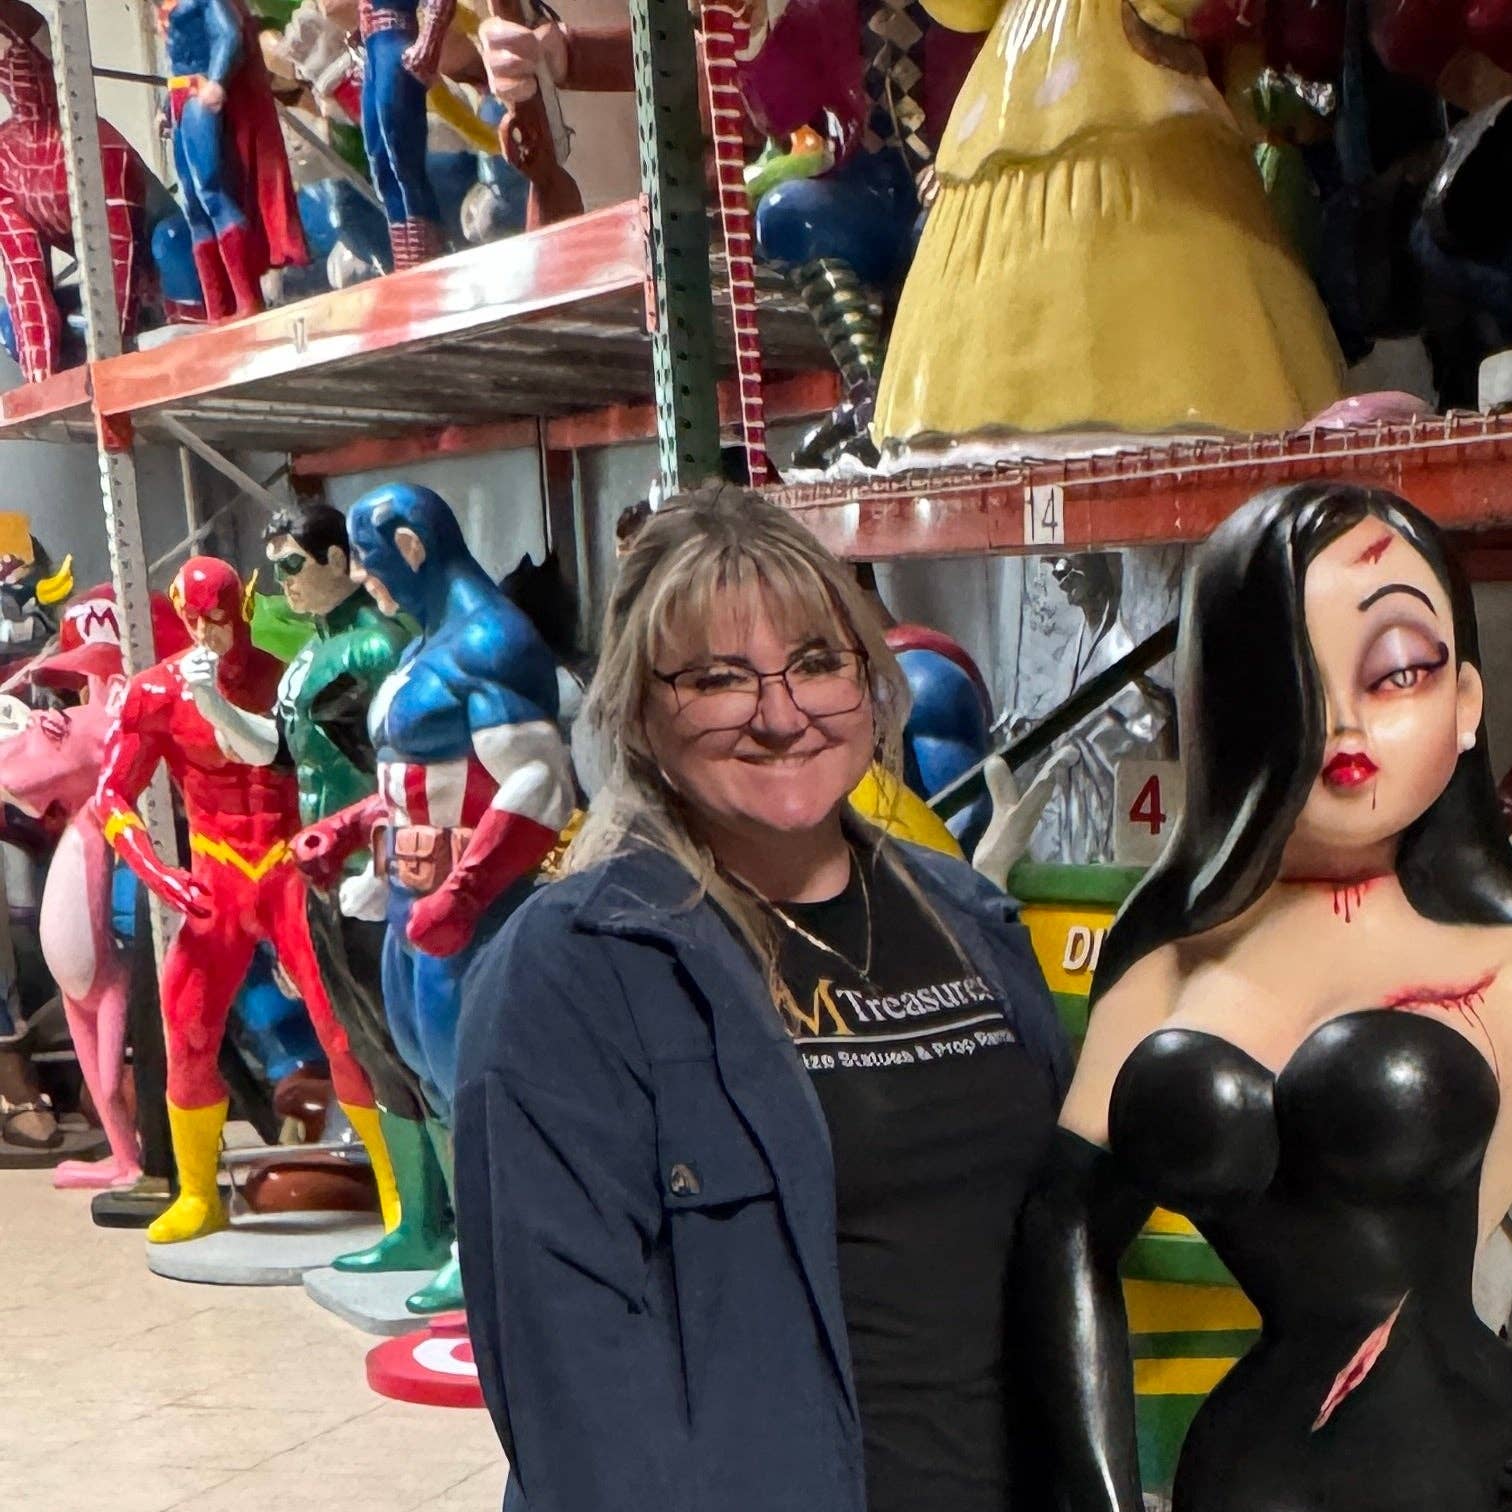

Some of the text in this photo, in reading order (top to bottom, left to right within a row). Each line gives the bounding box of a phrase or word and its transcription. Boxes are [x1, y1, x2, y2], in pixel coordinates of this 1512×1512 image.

[1025, 486, 1058, 544] 14
[84, 606, 121, 641] M
[1128, 774, 1167, 836] 4
